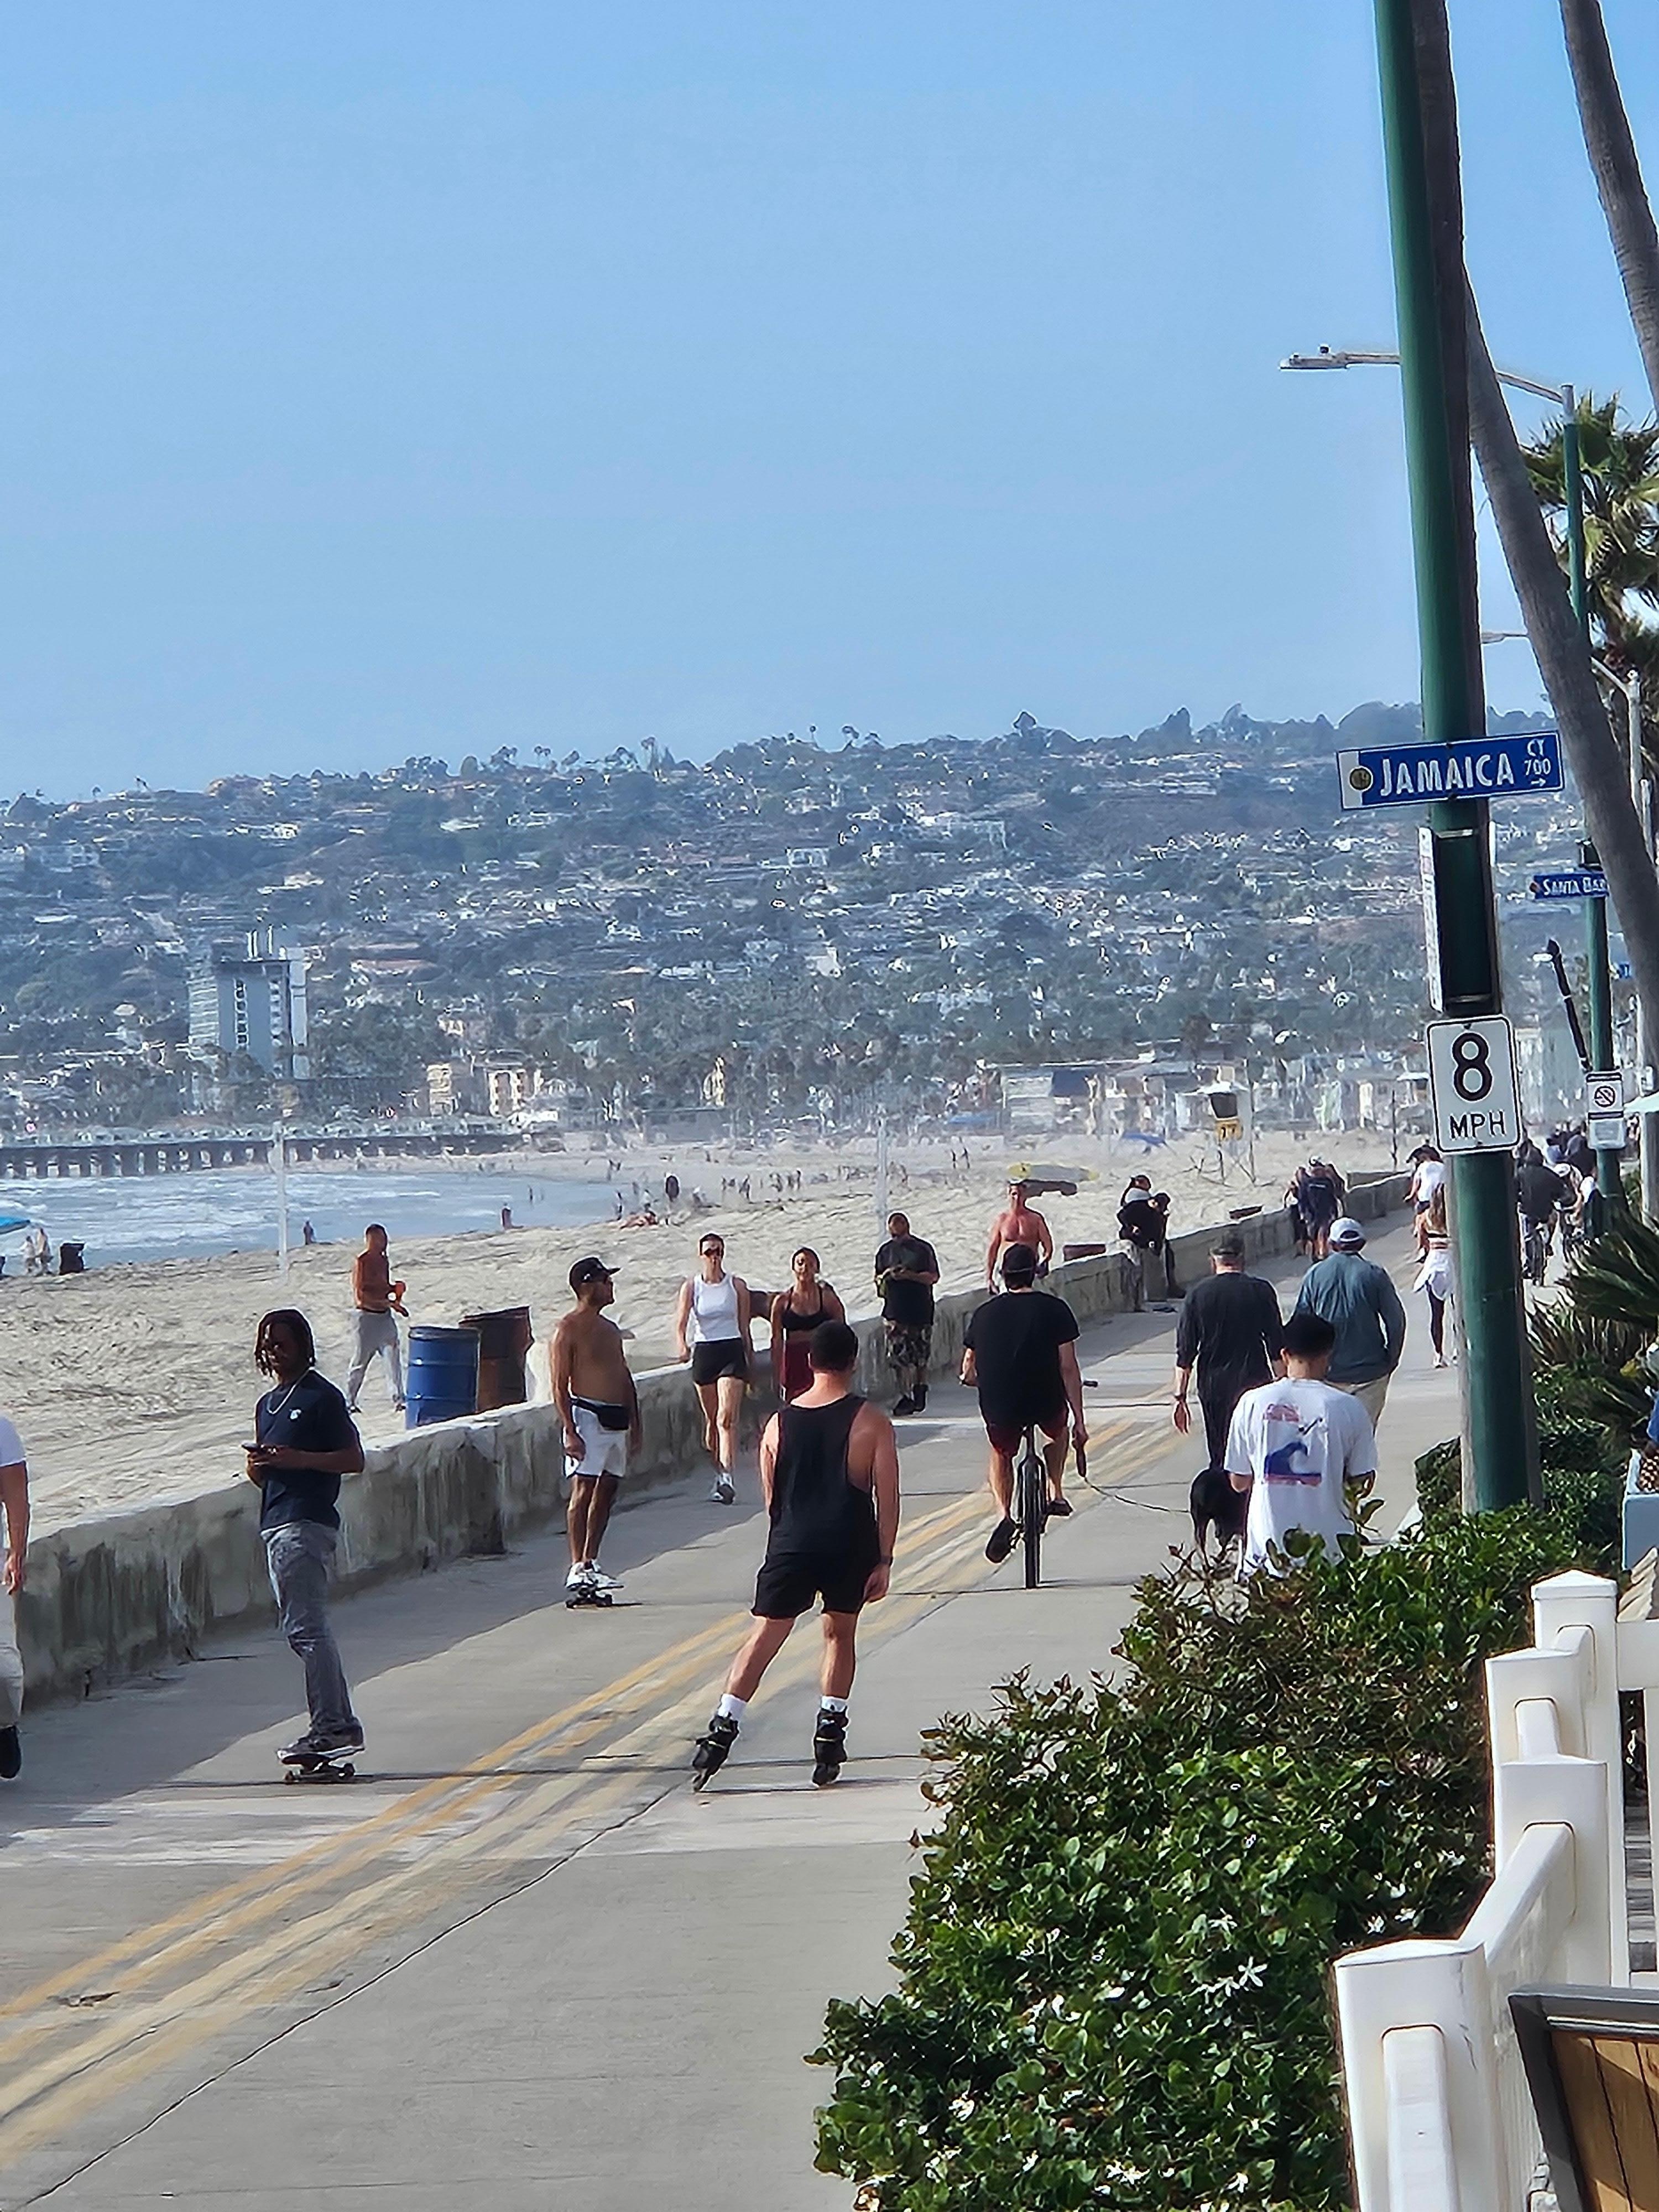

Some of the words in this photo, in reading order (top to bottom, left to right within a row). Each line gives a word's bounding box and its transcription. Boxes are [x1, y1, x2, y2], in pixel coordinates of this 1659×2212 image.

[1380, 753, 1515, 796] JAMAICA
[1524, 758, 1551, 775] 700
[1543, 879, 1581, 895] SANTA
[1452, 1032, 1493, 1101] 8
[1449, 1110, 1506, 1139] MPH
